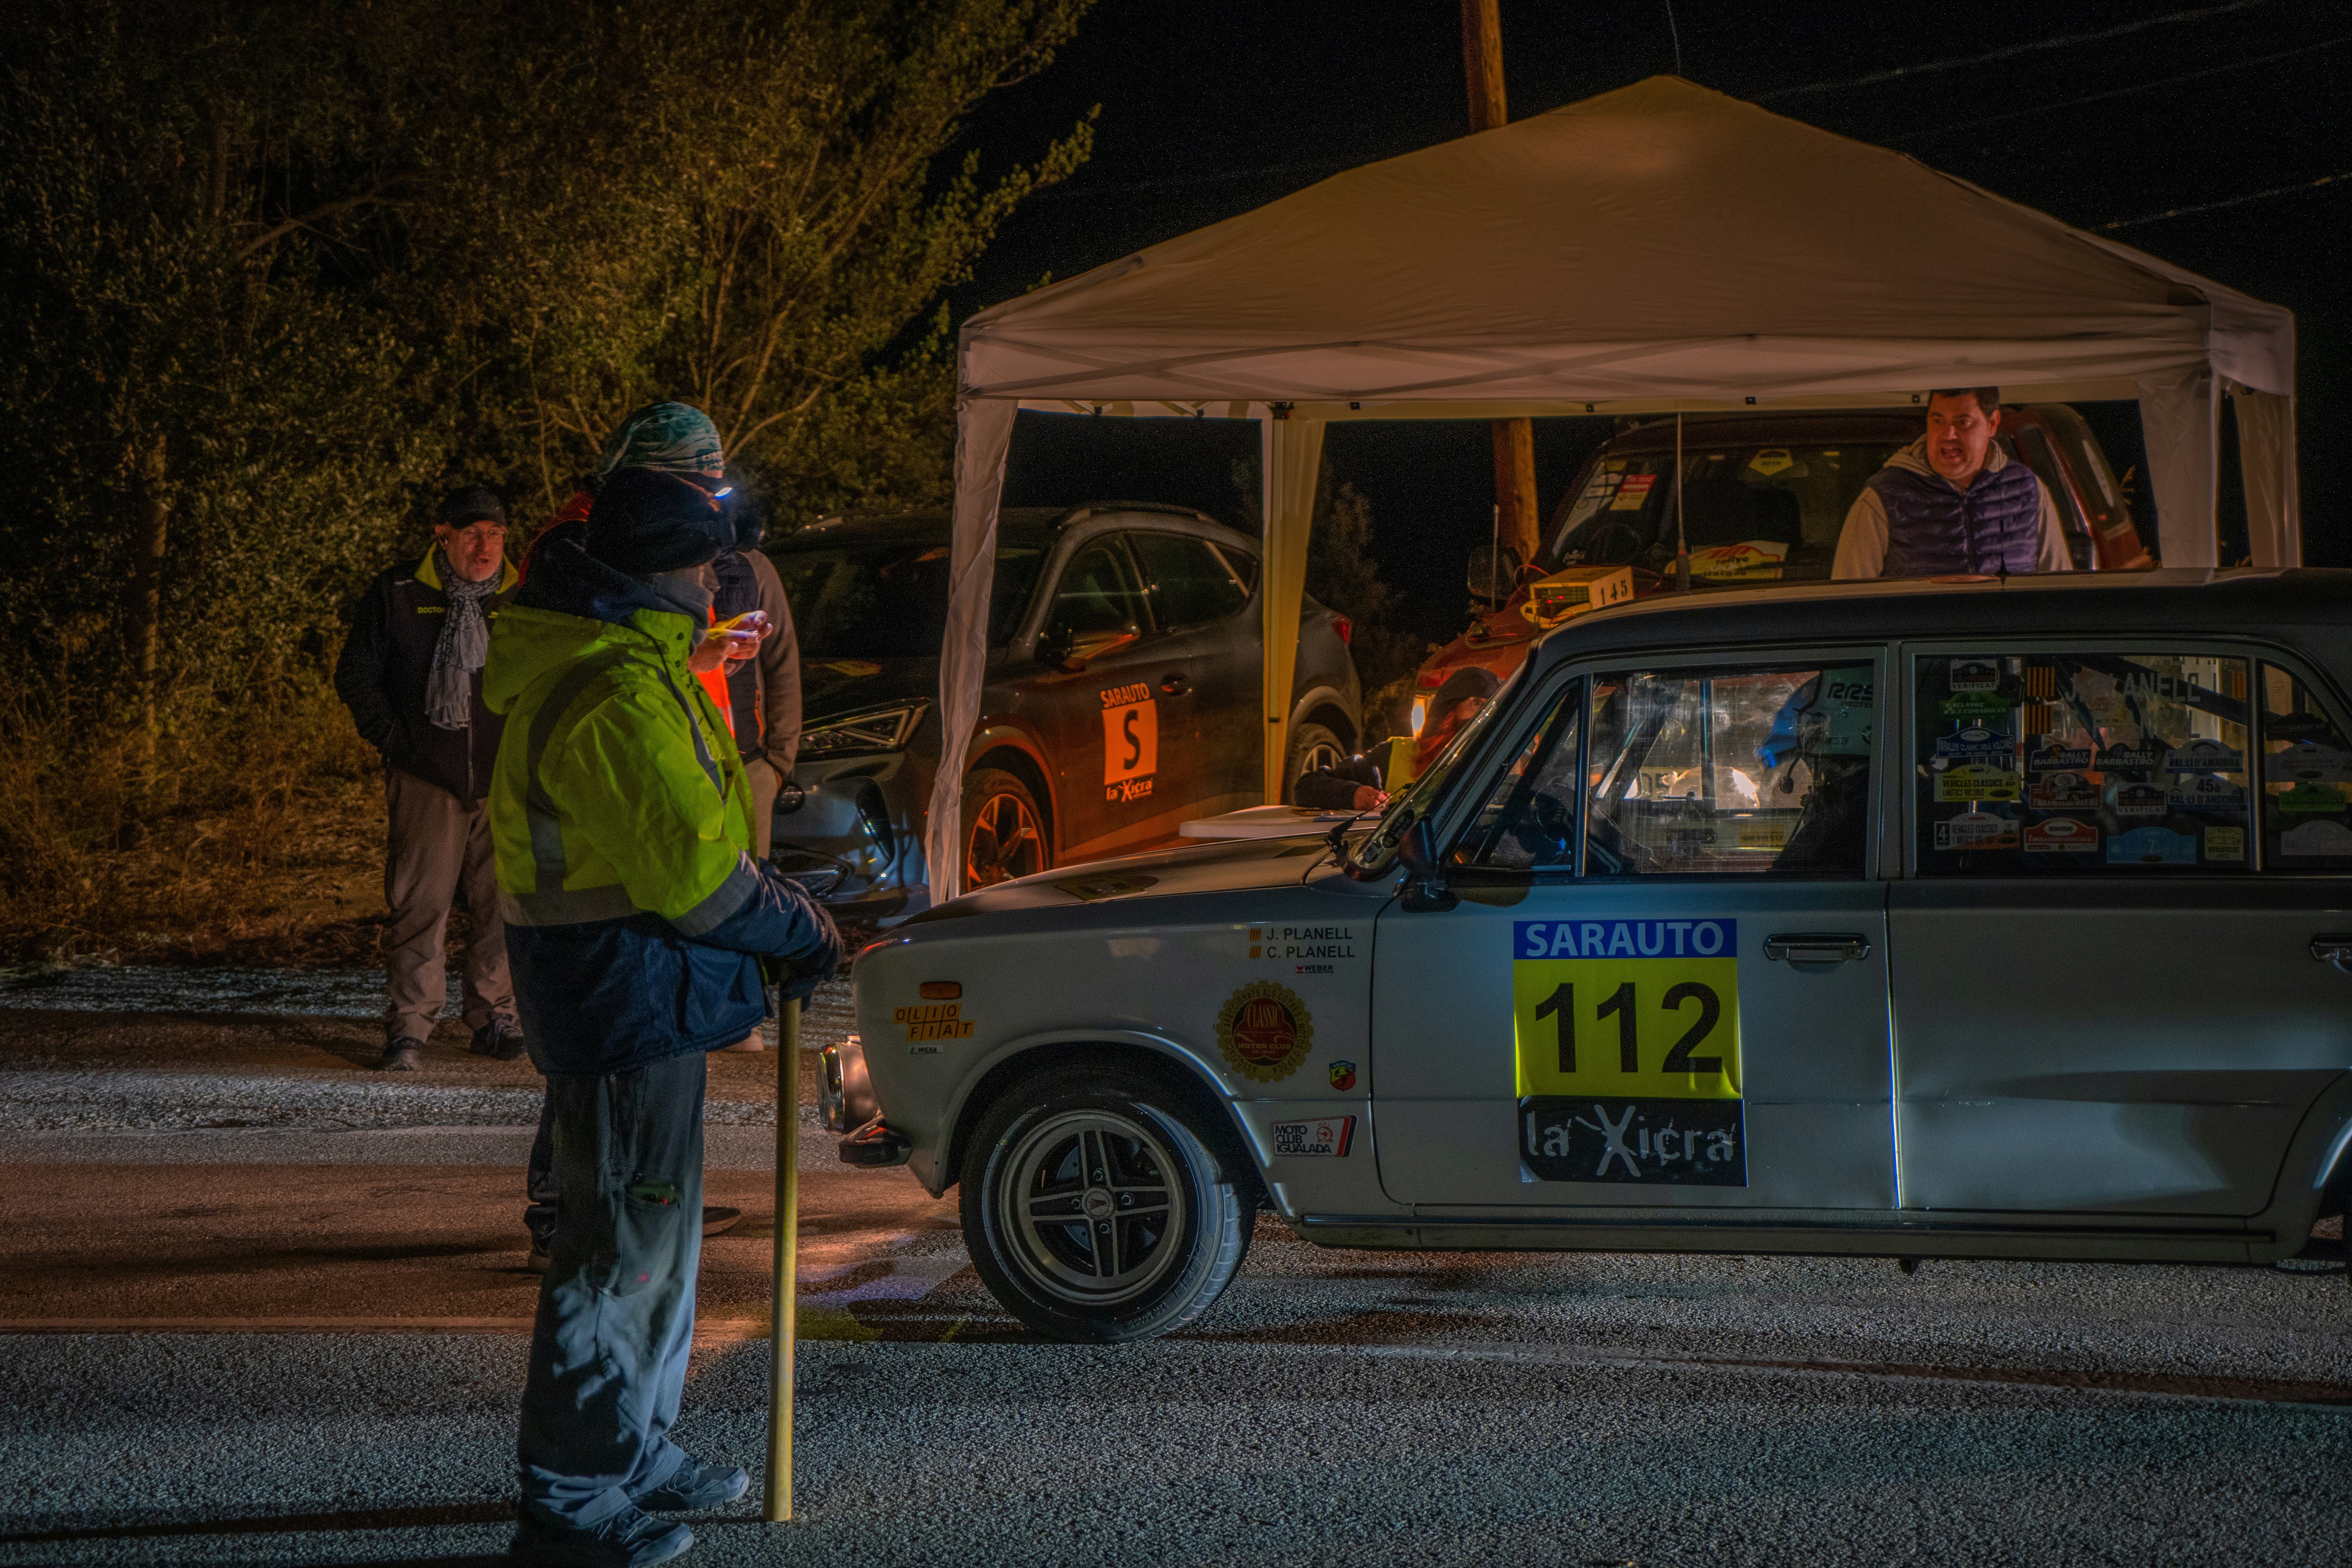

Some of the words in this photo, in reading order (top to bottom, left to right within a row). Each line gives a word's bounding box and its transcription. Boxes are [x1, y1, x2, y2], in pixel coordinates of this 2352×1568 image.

[1601, 579, 1628, 605] 145
[1100, 682, 1150, 708] SARAUTO
[1123, 709, 1141, 770] S
[1106, 787, 1118, 801] la
[1938, 825, 1947, 840] 4
[1267, 928, 1278, 940] J.
[1284, 927, 1353, 940] PLANELL
[1526, 922, 1724, 957] SARAUTO
[1267, 946, 1281, 958] C.
[1286, 946, 1356, 958] PLANELL
[896, 1005, 957, 1021] OLIO
[1263, 989, 1276, 997] ALS
[1278, 992, 1301, 1018] COTXES
[1297, 1023, 1306, 1050] MOTOS
[910, 1022, 971, 1038] FIAT
[1535, 981, 1723, 1074] 112
[1275, 1125, 1307, 1134] MOTO
[1526, 1109, 1572, 1156] la
[1276, 1134, 1303, 1144] CLUB
[1277, 1143, 1332, 1154] IGUALADA
